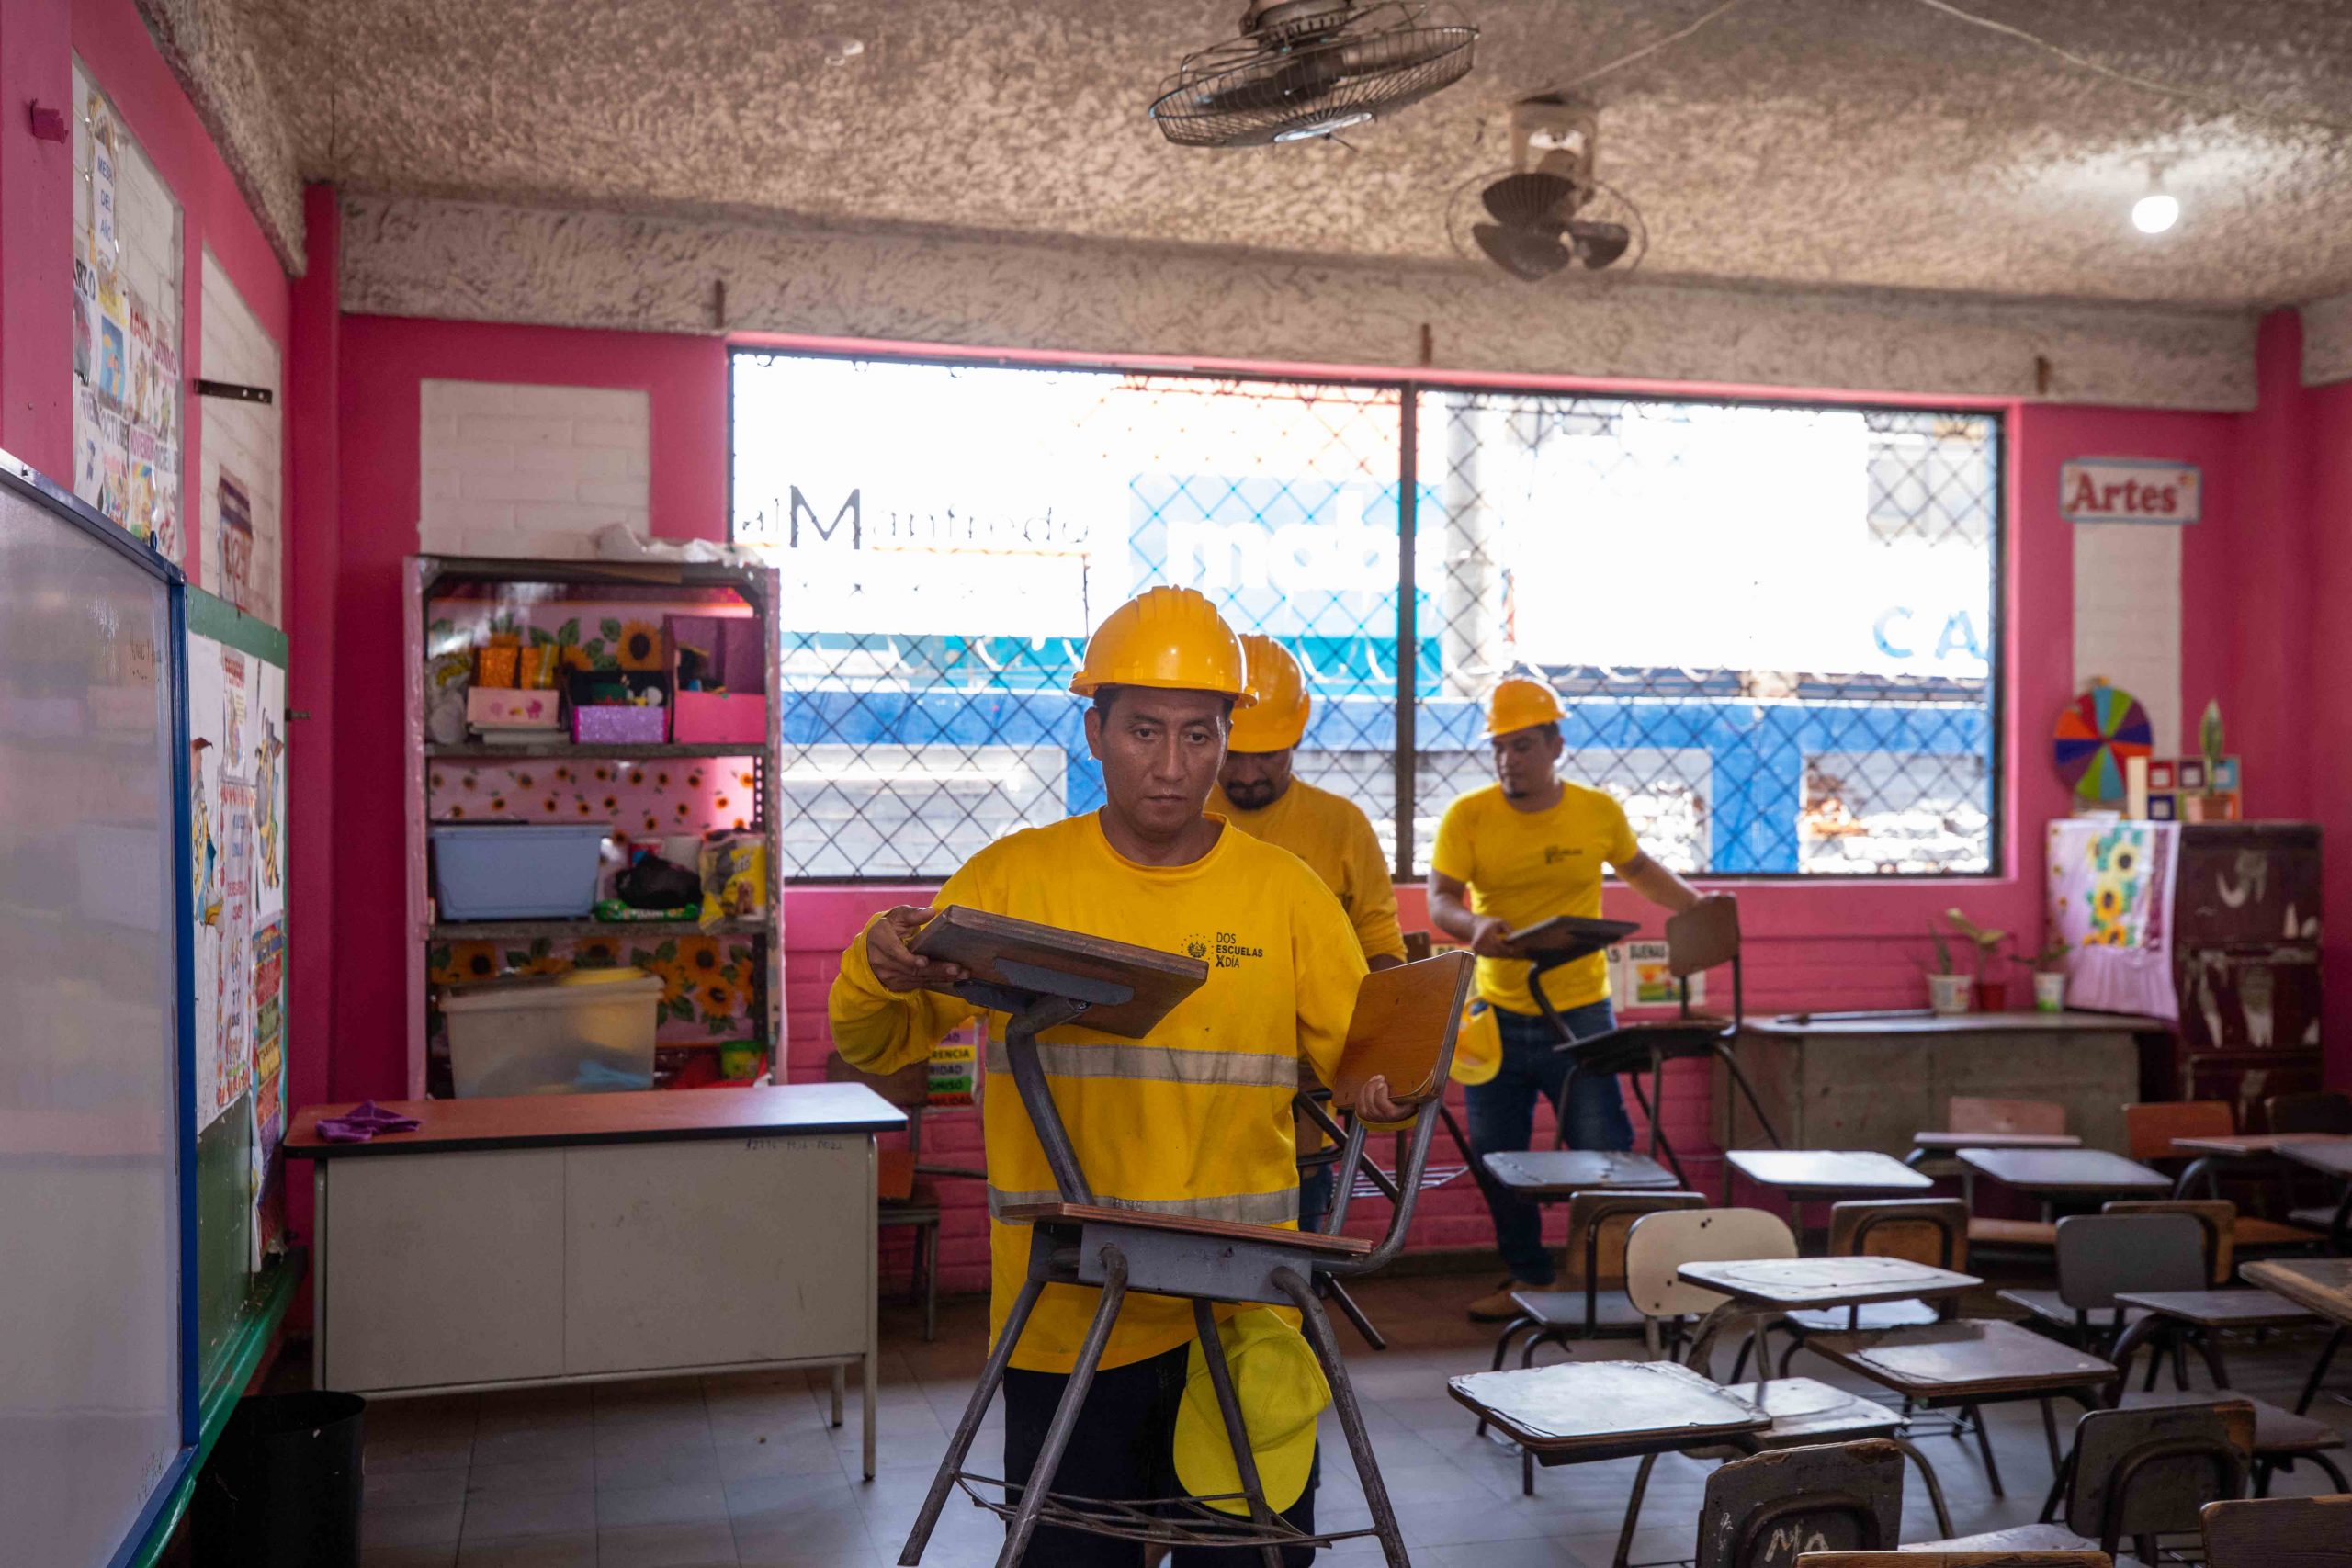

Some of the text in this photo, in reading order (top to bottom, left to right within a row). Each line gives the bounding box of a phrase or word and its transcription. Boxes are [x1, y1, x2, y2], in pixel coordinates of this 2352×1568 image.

[2064, 471, 2177, 513] Artes
[1216, 931, 1237, 944] DOS
[1216, 944, 1263, 958] ESCUELAS
